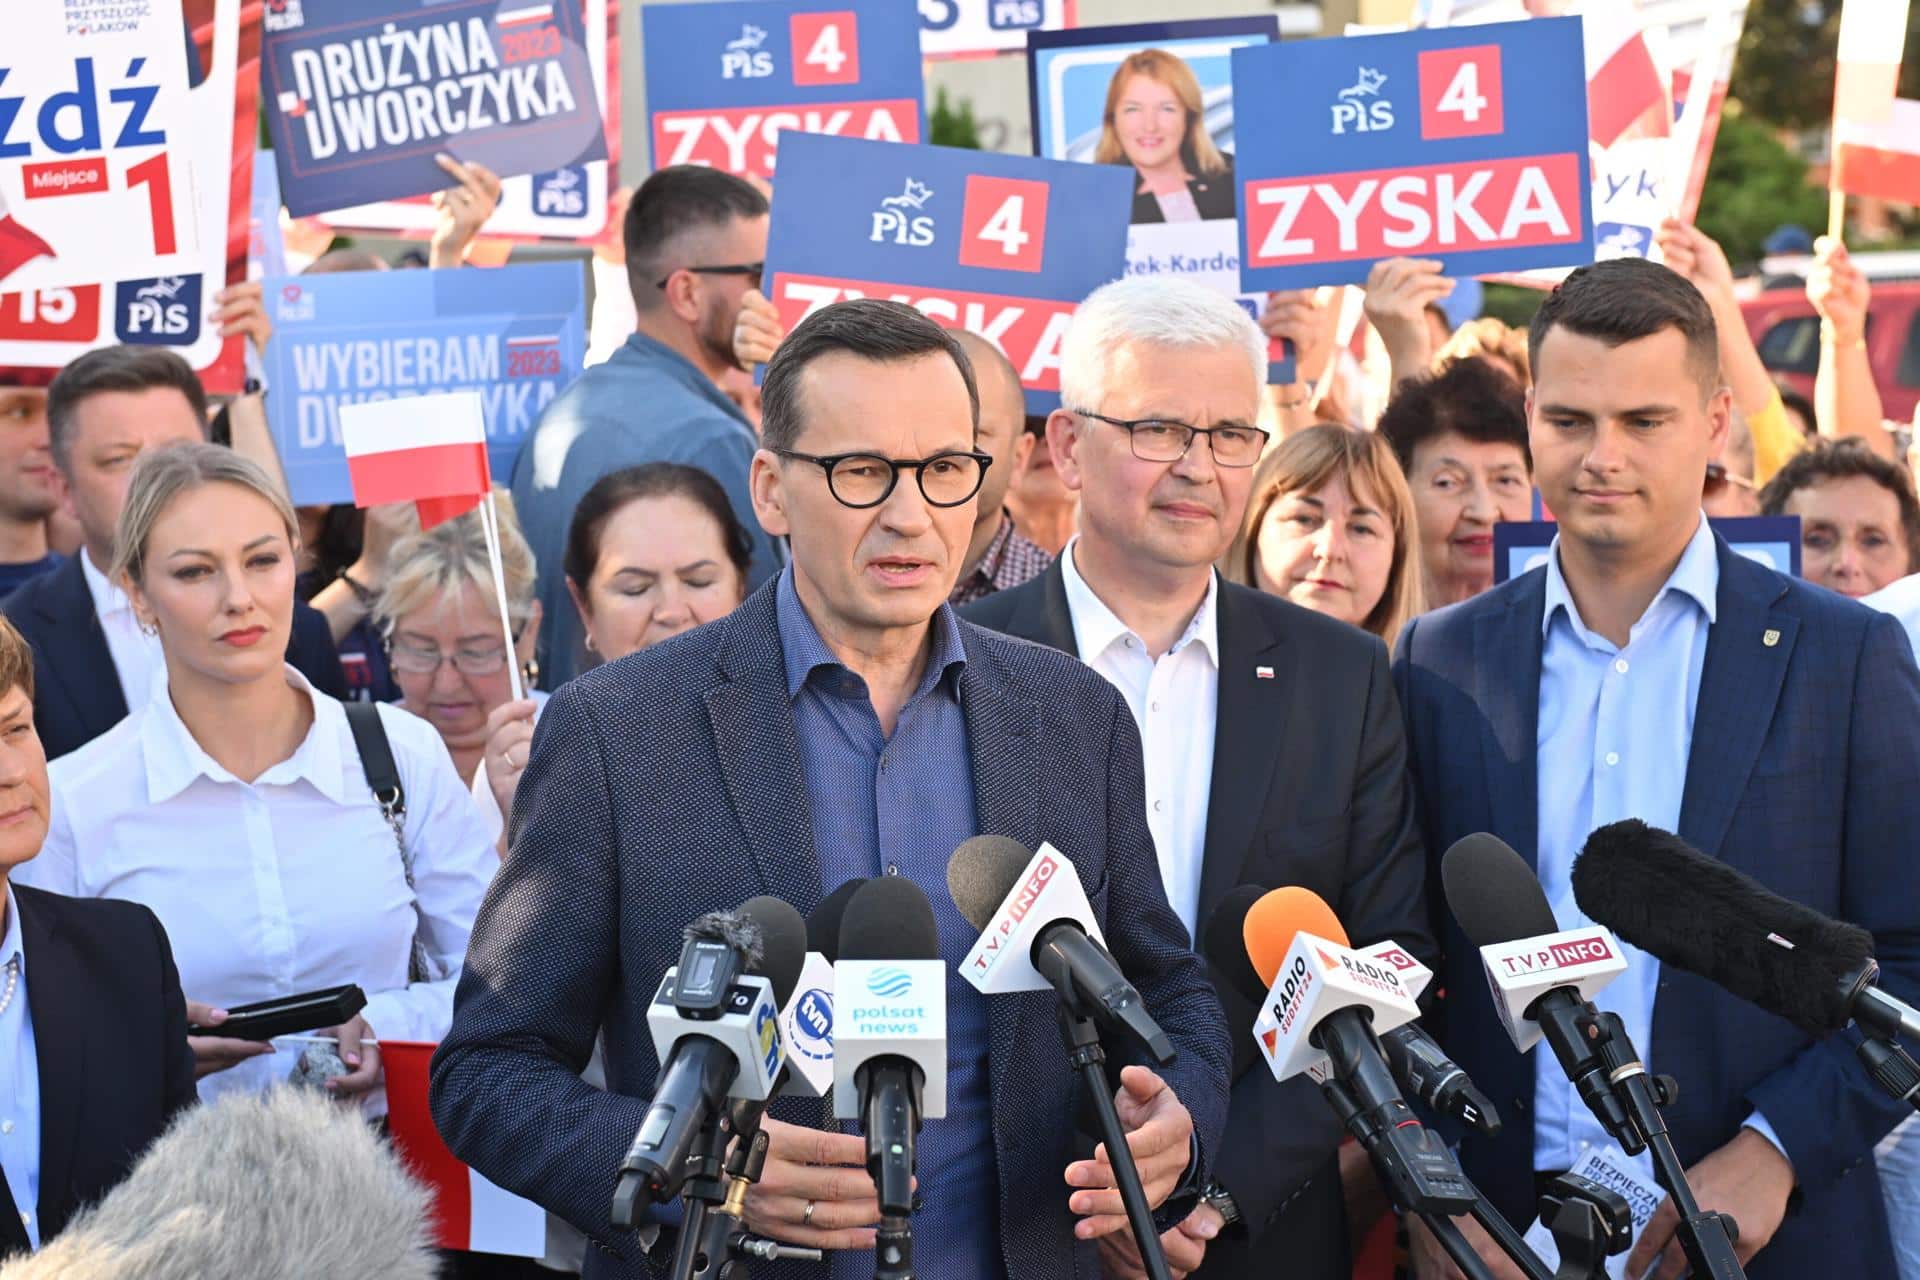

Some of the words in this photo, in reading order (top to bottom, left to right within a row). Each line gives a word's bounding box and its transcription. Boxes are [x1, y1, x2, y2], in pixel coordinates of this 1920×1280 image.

[501, 26, 562, 63] 2023
[805, 24, 846, 73] 4
[1436, 62, 1487, 122] 4
[32, 169, 99, 189] Miejsce
[126, 151, 177, 255] 1
[978, 195, 1029, 256] 4
[1257, 167, 1572, 258] ZYSKA
[293, 334, 500, 392] WYBIERAM
[507, 349, 561, 377] 2023
[1010, 857, 1056, 921] INFO
[1341, 955, 1399, 986] RADIO
[1552, 941, 1606, 965] INFO
[801, 994, 828, 1035] tvn
[853, 1004, 926, 1022] polsat
[1273, 956, 1305, 1024] RADIO
[860, 1024, 918, 1034] news
